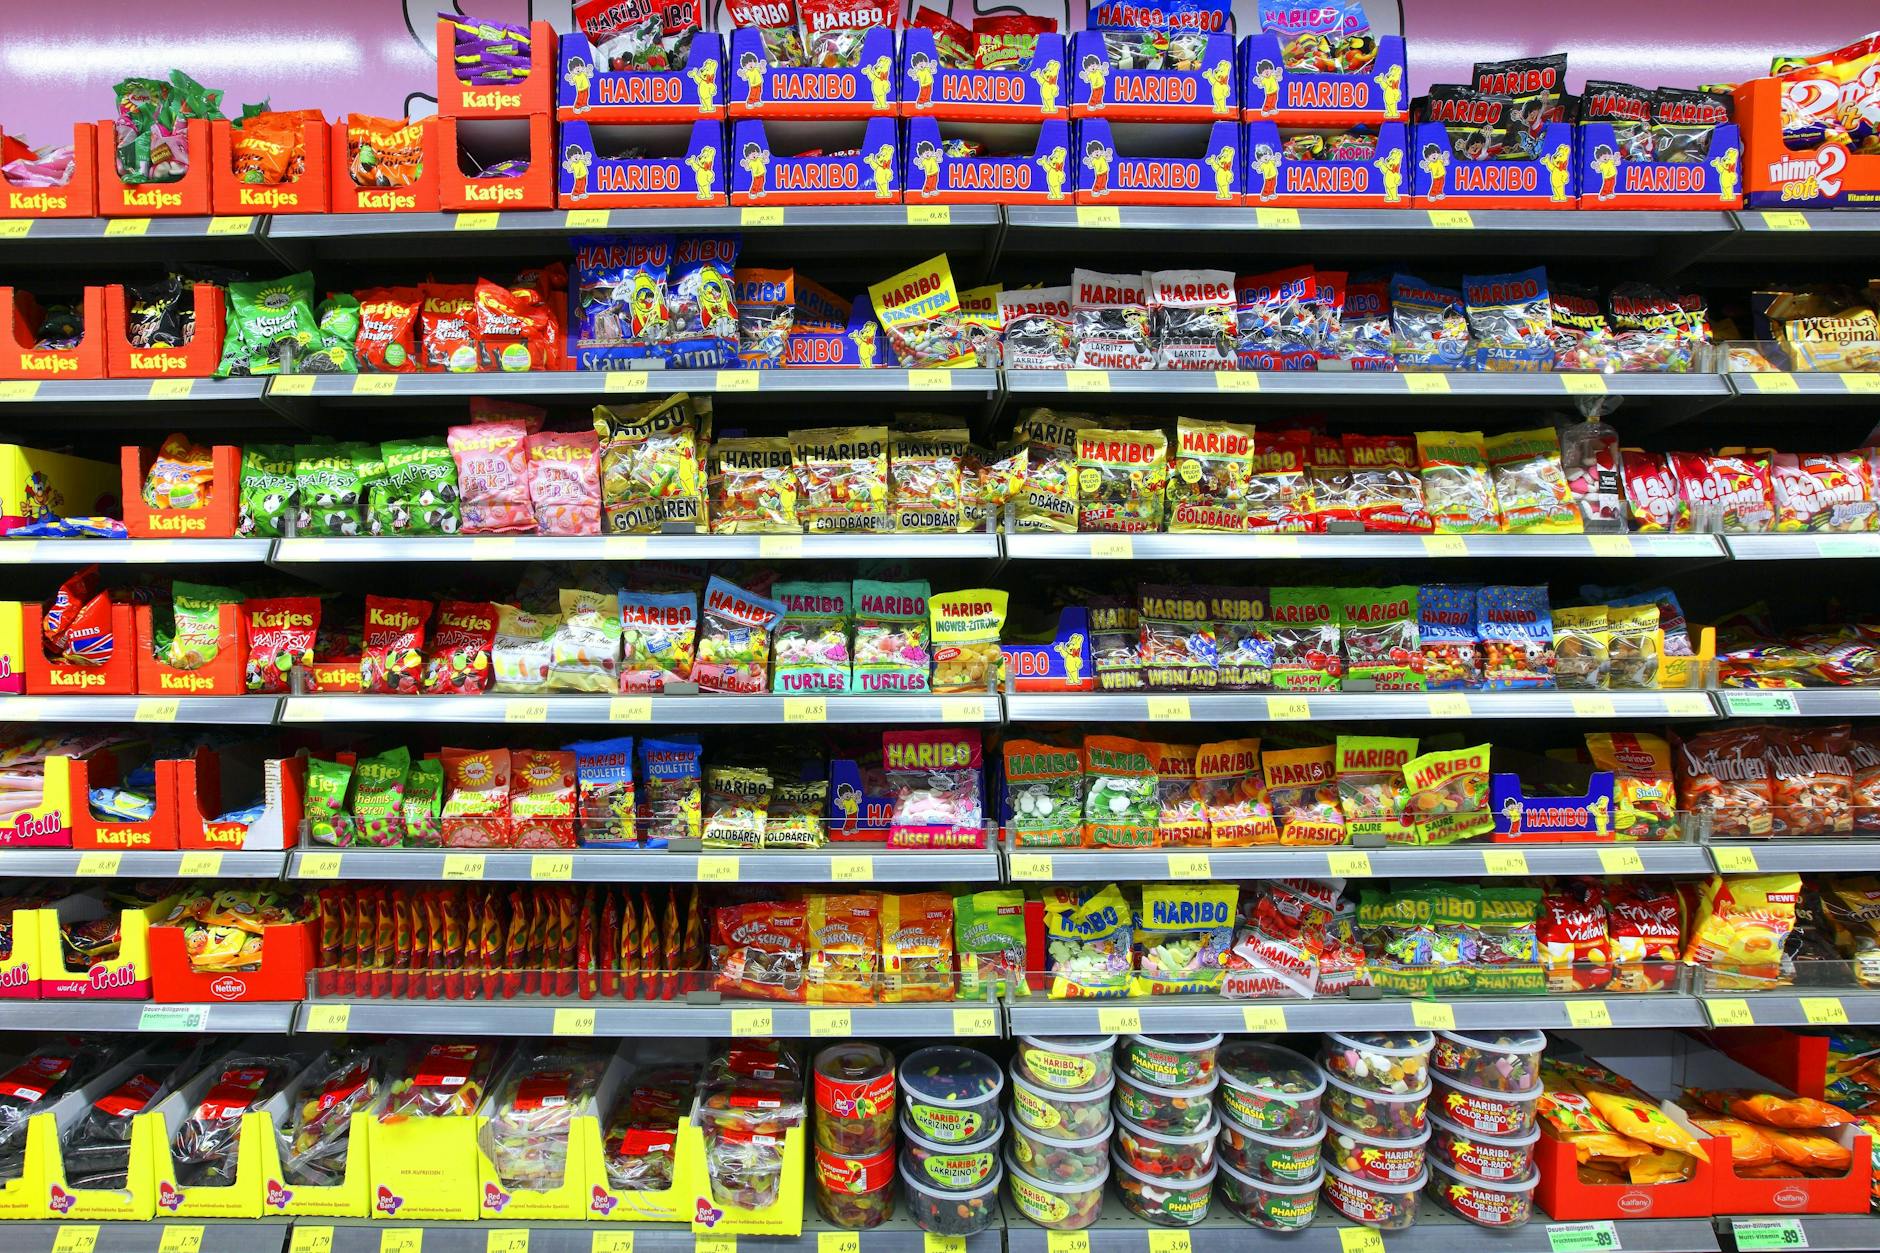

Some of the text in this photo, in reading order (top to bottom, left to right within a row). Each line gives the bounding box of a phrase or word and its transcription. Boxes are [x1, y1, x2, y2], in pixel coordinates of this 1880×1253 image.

[731, 6, 790, 27] HARIBO
[812, 7, 883, 31] HARIBO
[1097, 5, 1163, 27] HARIBO
[599, 77, 682, 104] HARIBO
[772, 74, 856, 100] HARIBO
[943, 75, 1026, 102] HARIBO
[1114, 76, 1197, 103] HARIBO
[1479, 67, 1556, 96] HARIBO
[462, 91, 521, 109] Katjes
[1288, 82, 1368, 108] HARIBO
[1430, 99, 1502, 124] HARIBO
[1589, 94, 1650, 120] HARIBO
[1658, 100, 1729, 123] HARIBO
[597, 165, 680, 191] HARIBO
[775, 163, 859, 189] HARIBO
[949, 163, 1032, 189] HARIBO
[1118, 163, 1200, 189] HARIBO
[1286, 166, 1369, 192] HARIBO
[1455, 166, 1538, 191] HARIBO
[1626, 166, 1705, 191] HARIBO
[465, 184, 524, 202] Katjes
[1782, 175, 1820, 201] soft
[9, 193, 67, 211] Katjes
[123, 189, 182, 208] Katjes
[239, 189, 298, 207] Katjes
[358, 191, 416, 210] Katjes
[577, 240, 668, 270] HARIBO
[882, 271, 941, 310] HARIBO
[1160, 283, 1229, 302] HARIBO
[1469, 279, 1538, 302] HARIBO
[882, 290, 951, 324] STAFETTEN
[1003, 300, 1069, 318] HARIBO
[483, 323, 522, 336] Kinder
[1090, 342, 1124, 353] LAKRITZ
[1174, 349, 1207, 359] LAKRITZ
[1487, 347, 1516, 359] SALZ
[21, 354, 79, 373] Katjes
[130, 354, 187, 373] Katjes
[1399, 353, 1429, 364] SALZ
[814, 441, 882, 462] HARIBO
[1081, 440, 1155, 465] HARIBO
[1183, 431, 1249, 456] HARIBO
[531, 446, 592, 463] Katjes
[726, 450, 792, 469] HARIBO
[466, 459, 507, 476] FRED
[149, 515, 207, 534] Katjes
[1085, 511, 1109, 522] SAFT
[1176, 506, 1244, 530] GOLDBÄREN
[708, 589, 774, 624] HARIBO
[781, 593, 844, 614] HARIBO
[861, 594, 925, 617] HARIBO
[942, 602, 993, 616] HARIBO
[1143, 598, 1206, 620] HARIBO
[1345, 600, 1410, 623] HARIBO
[252, 610, 313, 628] Katjes
[370, 607, 420, 631] Katjes
[439, 612, 492, 632] Katjes
[622, 604, 691, 627] HARIBO
[1423, 609, 1470, 625] HARIBO
[1487, 609, 1538, 623] HARIBO
[252, 629, 317, 650] TAPPSY
[436, 631, 487, 653] TAPPSY
[50, 670, 106, 688] Katjes
[160, 673, 215, 693] Katjes
[781, 671, 844, 691] TURTLES
[861, 671, 925, 691] TURTLES
[1148, 668, 1217, 687] WEINLAND
[1286, 675, 1322, 686] HAPPY
[1371, 671, 1406, 683] HAPPY
[578, 752, 626, 768] HARIBO
[647, 750, 695, 765] HARIBO
[887, 741, 971, 768] HARIBO
[1009, 752, 1078, 776] HARIBO
[1201, 751, 1254, 773] HARIBO
[1343, 749, 1408, 769] HARIBO
[580, 766, 626, 779] ROULETTE
[648, 762, 695, 774] ROULETTE
[1270, 760, 1335, 786] HARIBO
[1414, 756, 1482, 789] HARIBO
[714, 778, 767, 796] HARIBO
[512, 801, 570, 816] KIRSCHEN
[1526, 809, 1588, 827] HARIBO
[14, 810, 62, 838] Trolli
[1353, 822, 1382, 832] SAURE
[1425, 816, 1455, 832] SAURE
[96, 828, 151, 847] Katjes
[892, 828, 930, 847] SÜSSE
[1093, 826, 1154, 846] QUAXI
[1768, 894, 1796, 904] REWE
[853, 908, 870, 917] REWE
[927, 911, 944, 920] REWE
[998, 907, 1016, 915] REWE
[1153, 901, 1228, 924] HARIBO
[774, 917, 795, 927] REWE
[1246, 934, 1312, 979] PRIMAVERA
[57, 961, 136, 996] world of Trolli
[1475, 974, 1544, 989] PHANTASIA
[215, 984, 243, 993] Netten
[1043, 1056, 1075, 1069] HARIBO
[1047, 1066, 1076, 1077] SAURES
[1131, 1054, 1178, 1076] PHANTASIA
[1455, 1106, 1507, 1124] COLOR-RADO
[1468, 1098, 1503, 1113] HARIBO
[929, 1111, 960, 1124] HARIBO
[1385, 1150, 1414, 1160] HARIBO
[1461, 1154, 1512, 1170] COLOR-RADO
[1475, 1146, 1509, 1159] HARIBO
[929, 1166, 972, 1177] LAKRIZINO
[946, 1159, 976, 1170] HARIBO
[1271, 1158, 1316, 1170] PHANTASIA
[1370, 1160, 1415, 1171] COLOR-RADO
[53, 1201, 69, 1209] Band
[54, 1195, 66, 1203] Red
[162, 1198, 178, 1206] Band
[269, 1196, 285, 1204] Band
[379, 1201, 396, 1210] Band
[381, 1195, 393, 1203] Red
[594, 1201, 611, 1209] Band
[1328, 1189, 1373, 1212] COLOR-RADO
[1458, 1197, 1508, 1214] COLOR-RADO
[1472, 1190, 1506, 1203] HARIBO
[1620, 1198, 1650, 1208] kalfany
[1776, 1194, 1806, 1204] kalfany
[698, 1213, 715, 1222] Band
[700, 1207, 712, 1215] Red
